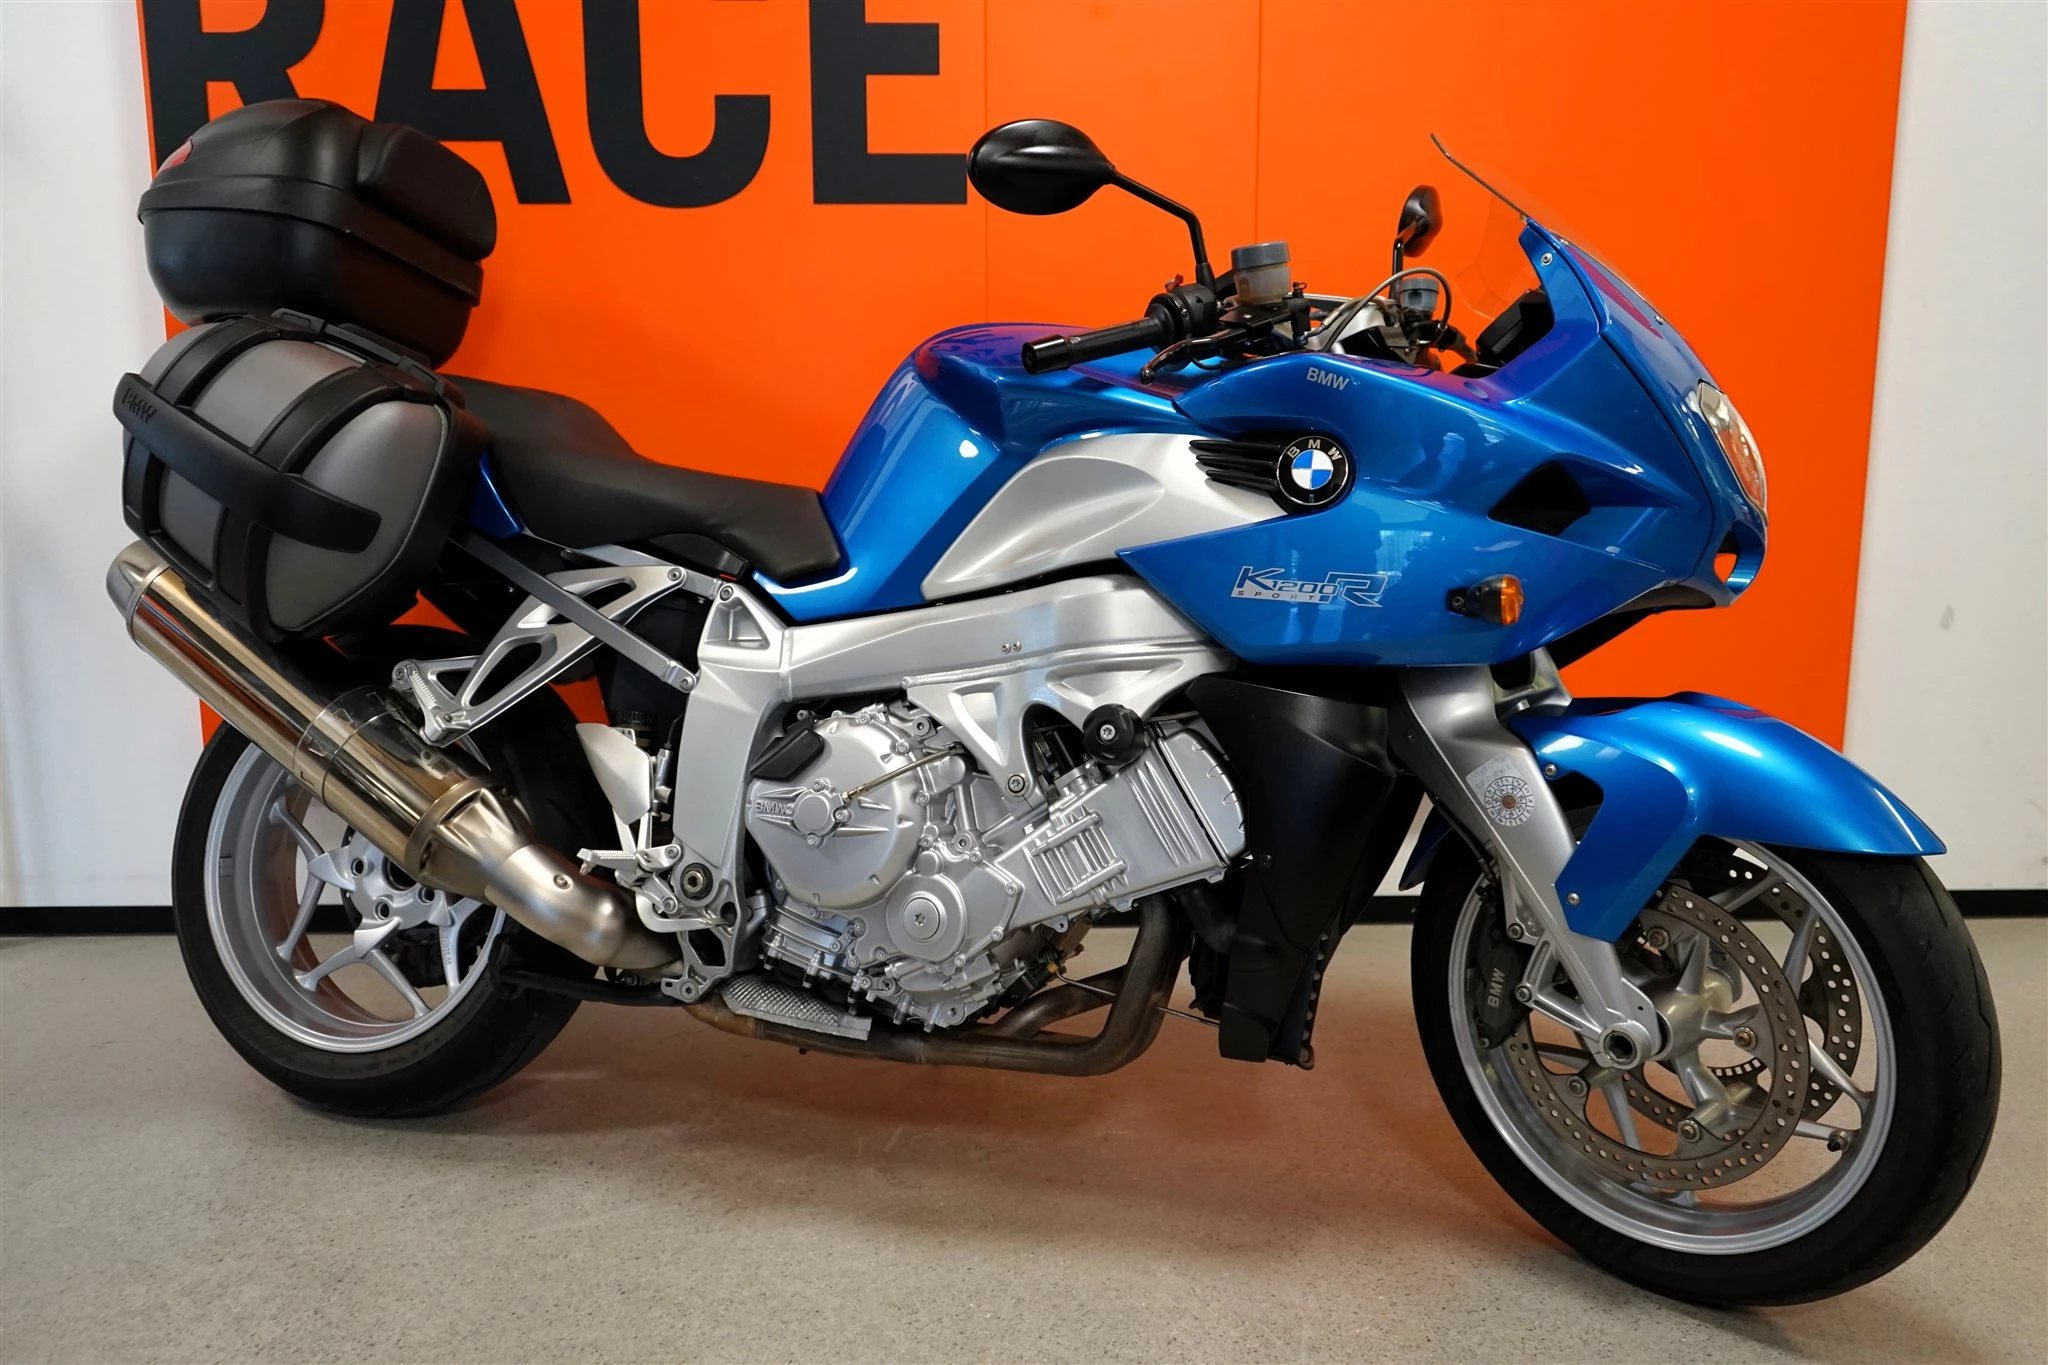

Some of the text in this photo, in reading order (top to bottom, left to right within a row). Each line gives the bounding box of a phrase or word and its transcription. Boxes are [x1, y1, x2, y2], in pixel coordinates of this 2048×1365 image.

[1306, 367, 1350, 391] BMW
[122, 387, 160, 424] BMW
[1287, 439, 1343, 461] BMW
[1236, 590, 1316, 601] SPORT
[1487, 967, 1505, 1009] BMW
